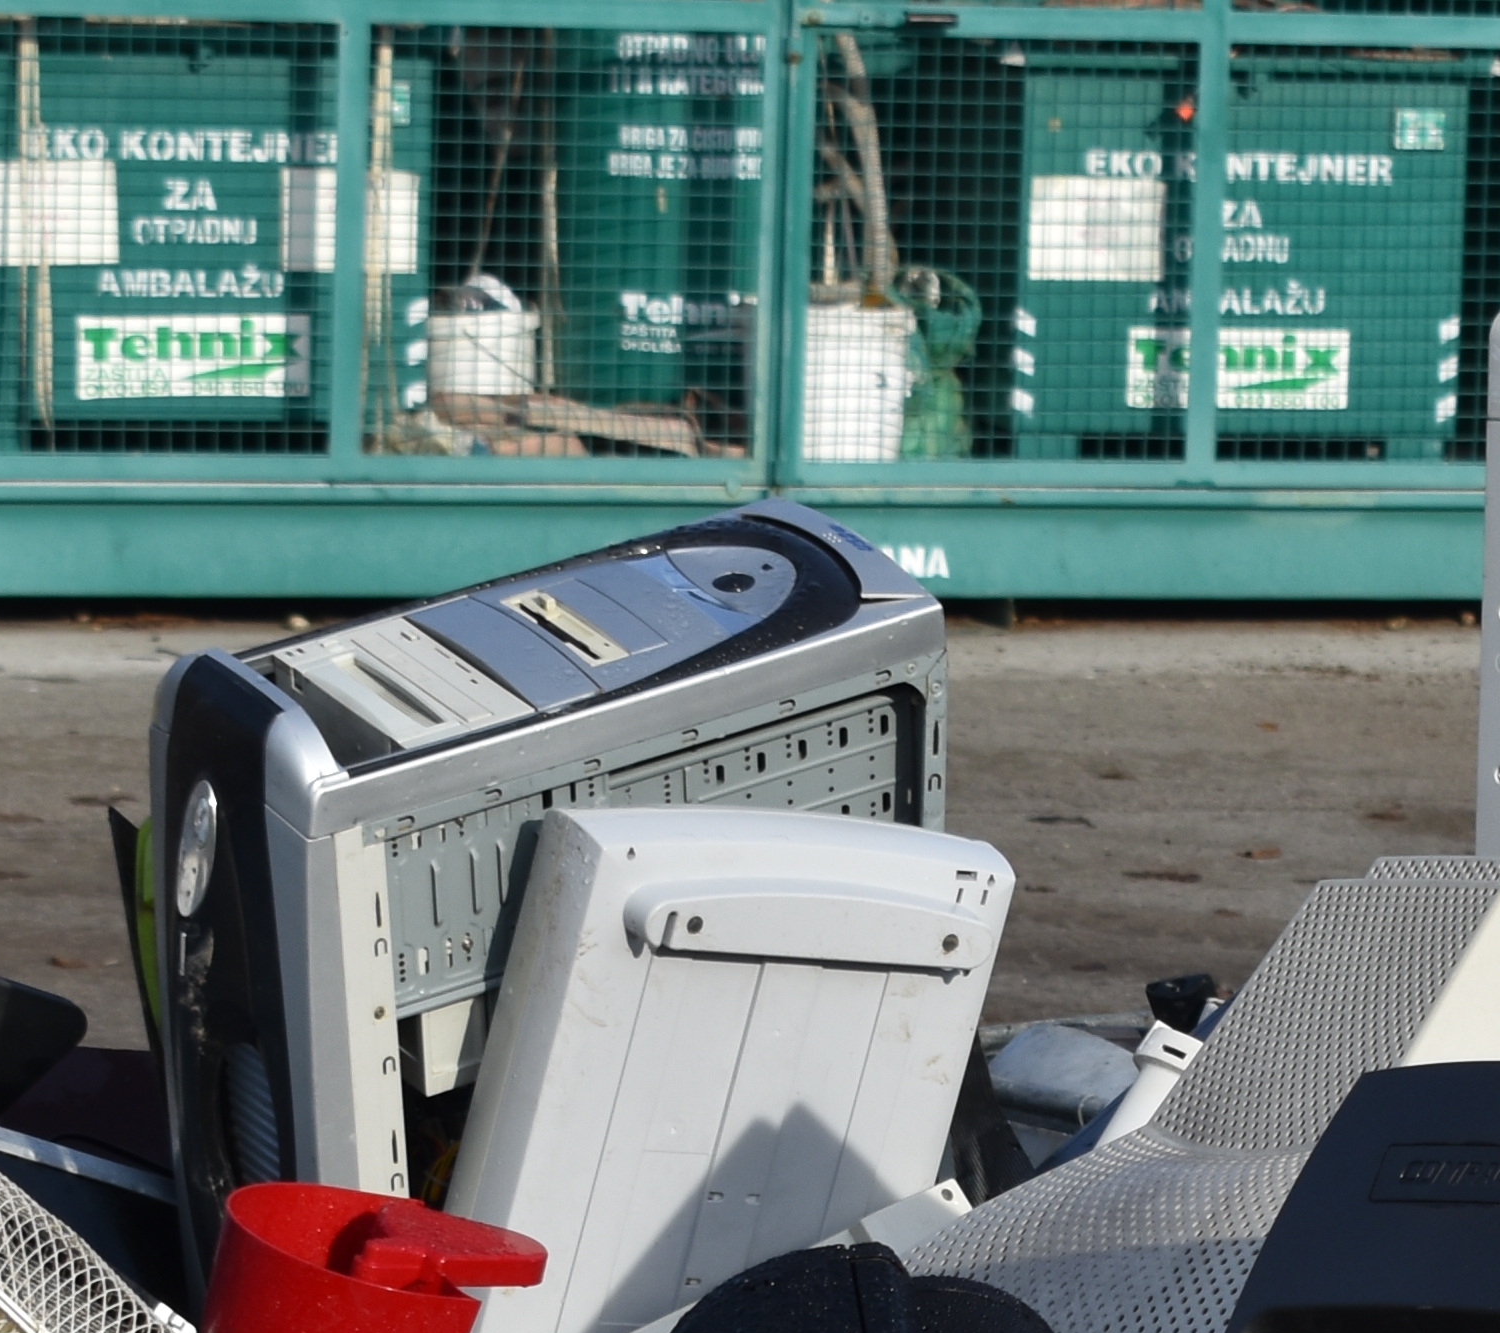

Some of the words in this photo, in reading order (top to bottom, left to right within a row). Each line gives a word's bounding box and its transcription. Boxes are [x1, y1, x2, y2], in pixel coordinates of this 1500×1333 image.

[1086, 150, 1163, 179] EKO
[1176, 151, 1394, 184] KNTEJNER
[163, 177, 218, 211] ZA
[132, 217, 258, 245] OTPADNU
[1174, 237, 1289, 264] OADNU
[98, 263, 286, 299] AMBALAŽU
[1149, 279, 1326, 315] AMALAŽU
[83, 317, 303, 361] Tehnix
